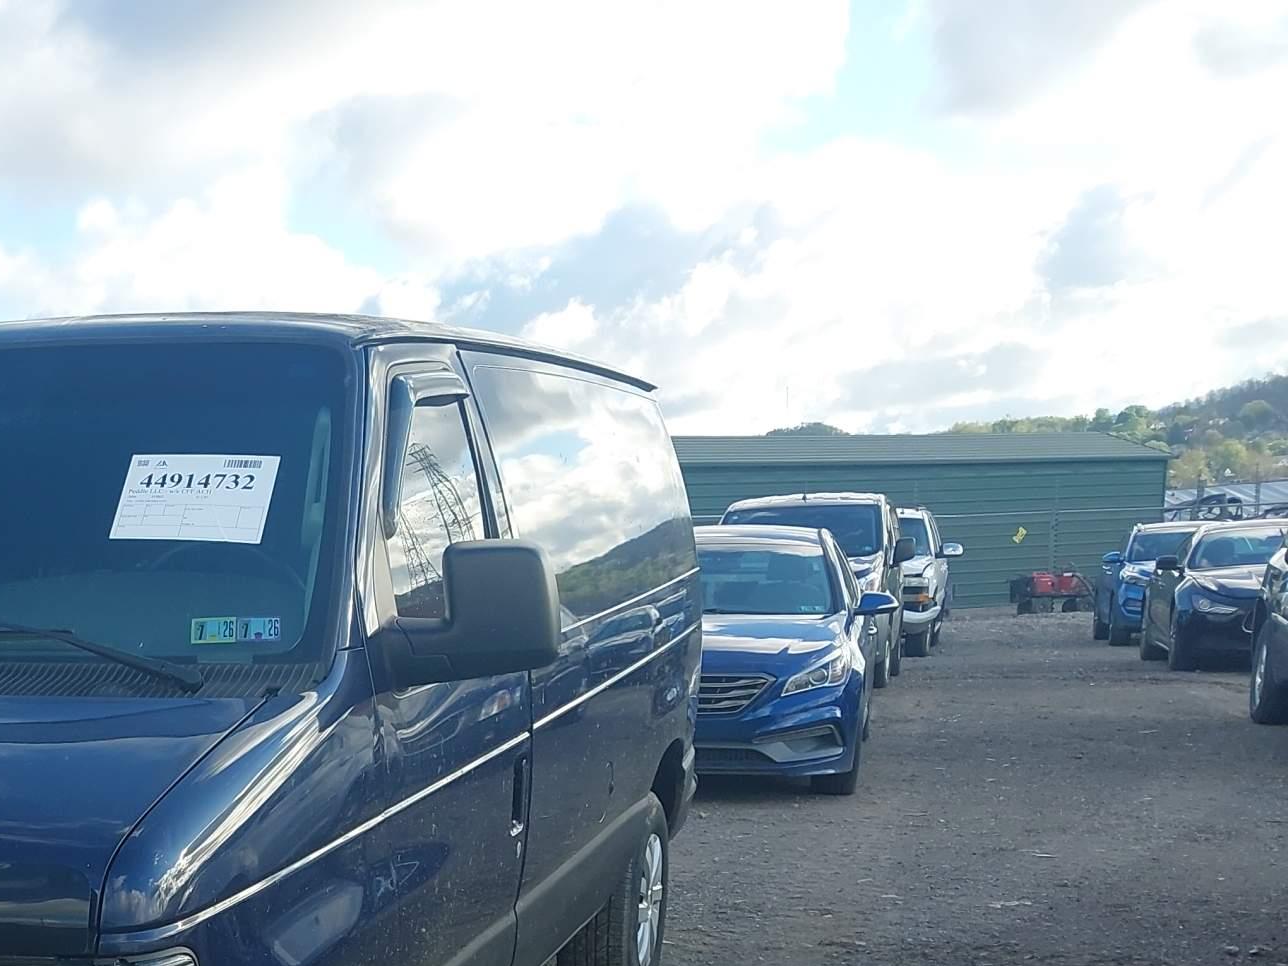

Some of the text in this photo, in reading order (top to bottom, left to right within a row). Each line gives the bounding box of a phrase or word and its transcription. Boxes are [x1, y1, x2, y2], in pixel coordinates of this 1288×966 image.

[140, 473, 255, 489] 44914732
[223, 621, 234, 637] 26
[268, 619, 279, 636] 26
